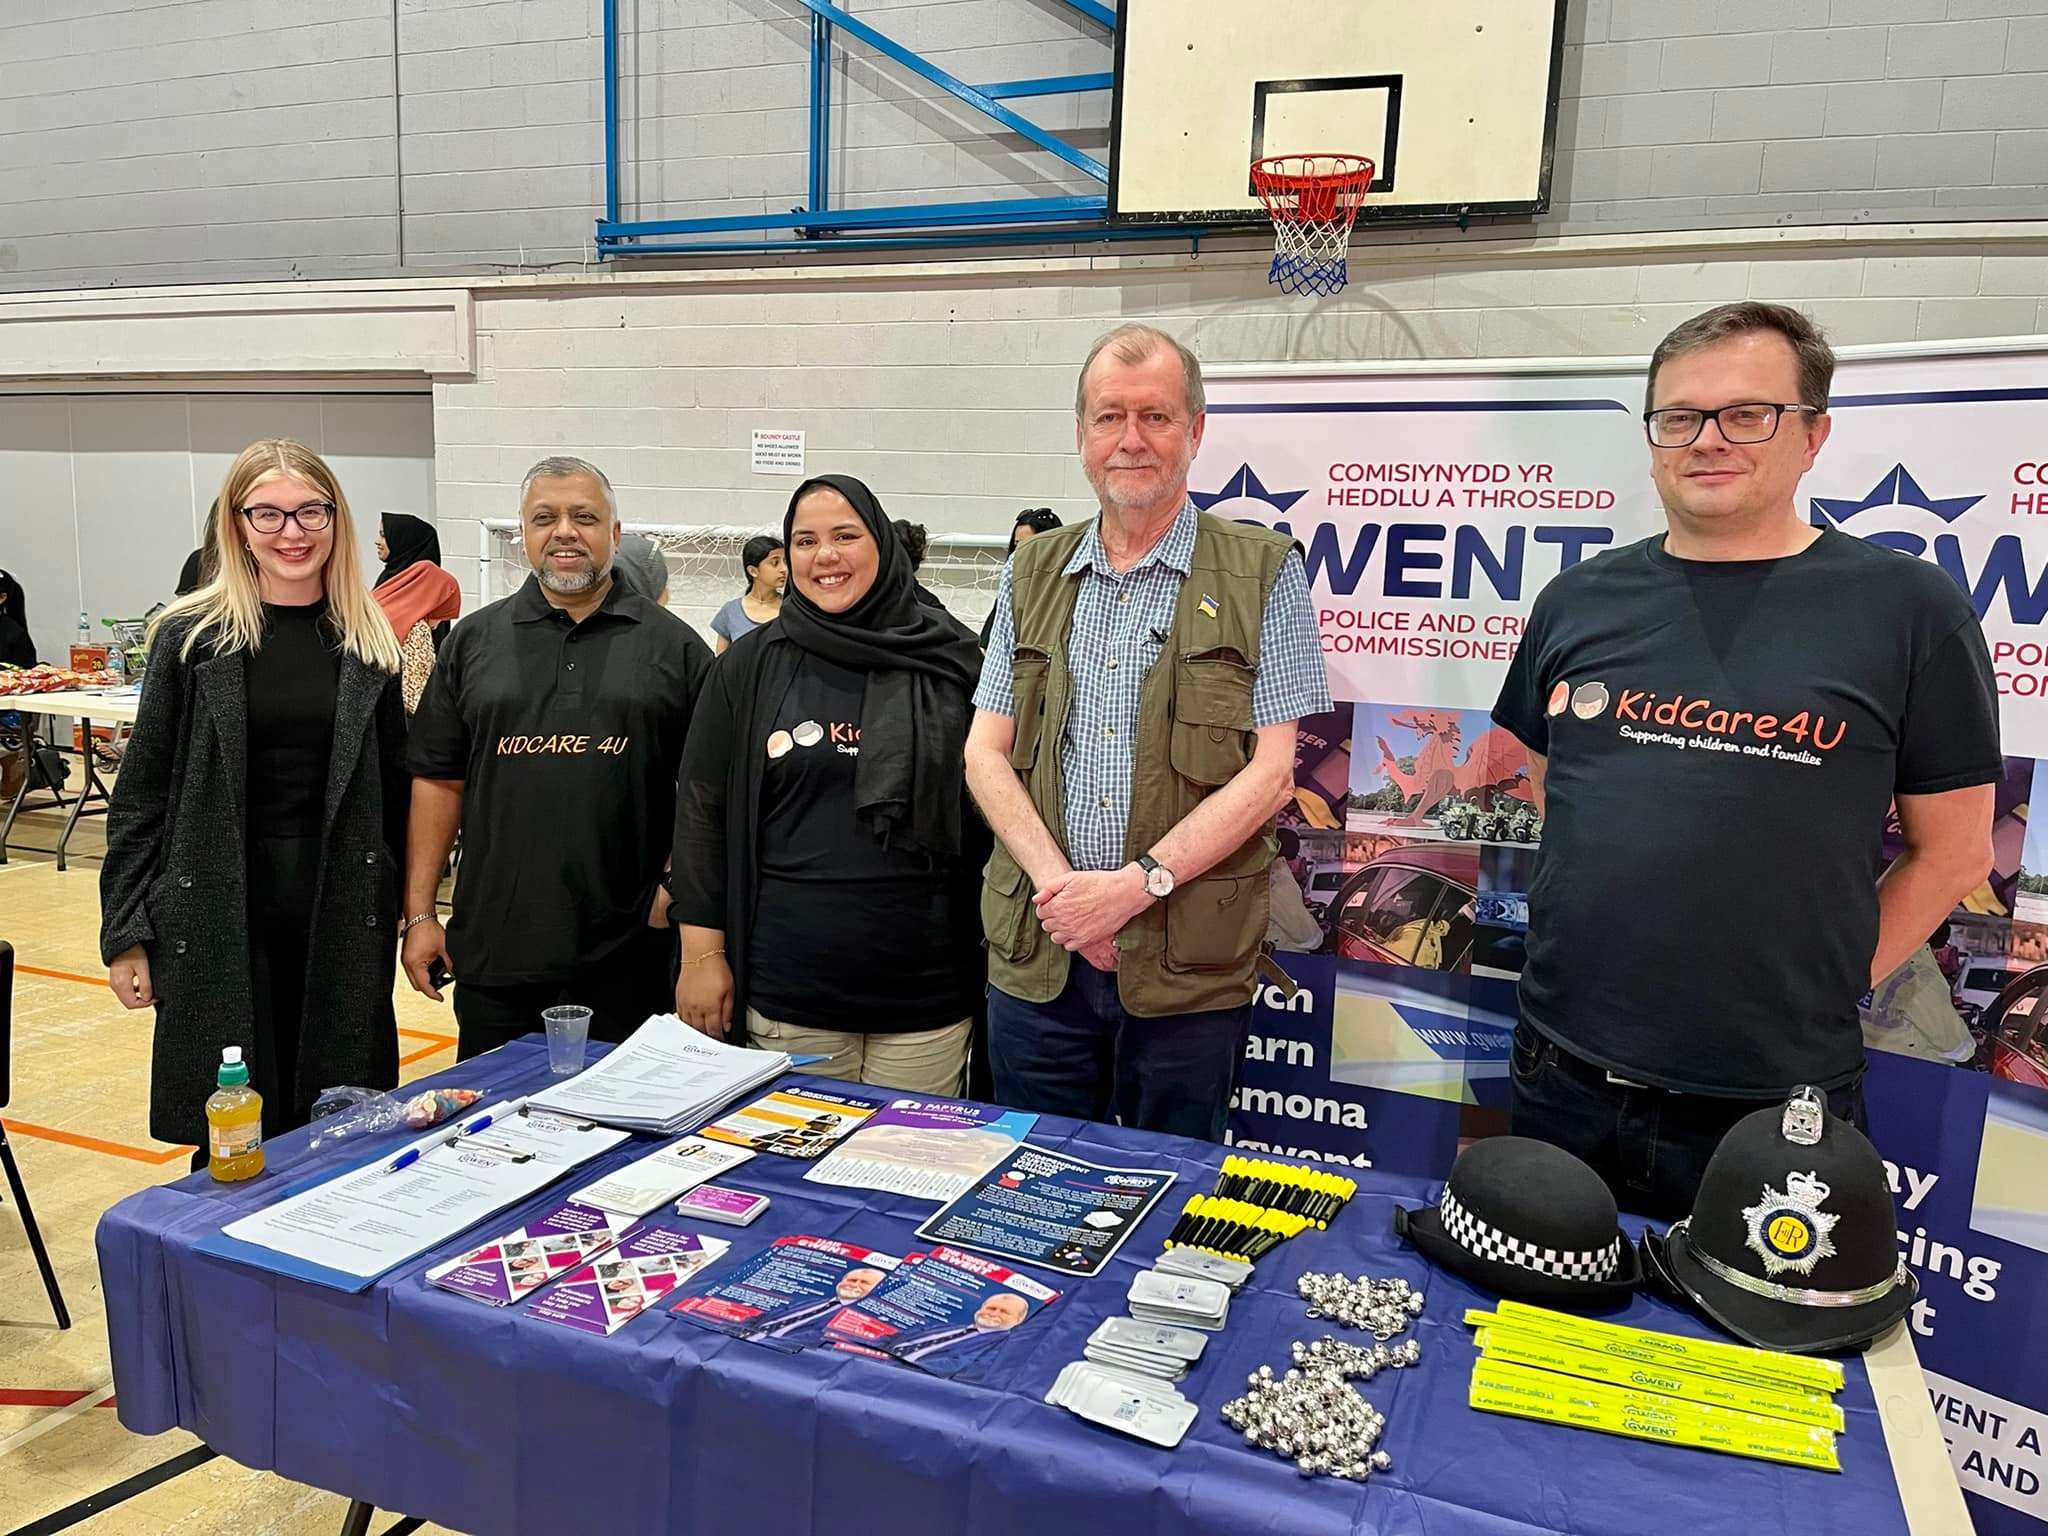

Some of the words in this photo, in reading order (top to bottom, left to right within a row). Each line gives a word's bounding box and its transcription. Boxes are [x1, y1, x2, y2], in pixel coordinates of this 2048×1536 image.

[1328, 462, 1510, 483] COMISIYNYDD
[1518, 464, 1554, 484] YR
[1326, 488, 1430, 508] HEDDLU
[1436, 490, 1456, 509] A
[1461, 490, 1617, 511] THROSEDD
[2010, 492, 2048, 515] HE
[1319, 609, 1410, 631] POLICE
[1418, 613, 1476, 634] AND
[1484, 615, 1527, 636] CRI
[1993, 641, 2048, 667] PO
[1615, 688, 1847, 750] KidCare4U
[497, 734, 591, 756] KIDCARE
[597, 736, 629, 756] 4U
[836, 743, 860, 757] Supp
[1618, 725, 1686, 749] Supporting
[1688, 735, 1741, 753] children
[1743, 742, 1771, 758] and
[1771, 744, 1823, 767] families
[923, 1103, 981, 1115] PAPYRUS
[1229, 1087, 1368, 1130] smona
[1024, 1152, 1091, 1174] INDEPENDENT
[797, 1239, 850, 1254] GWENT
[939, 1253, 993, 1275] GWENT
[1625, 1419, 1679, 1438] GWENT
[2015, 1428, 2041, 1456] A
[1961, 1451, 2040, 1495] AND
